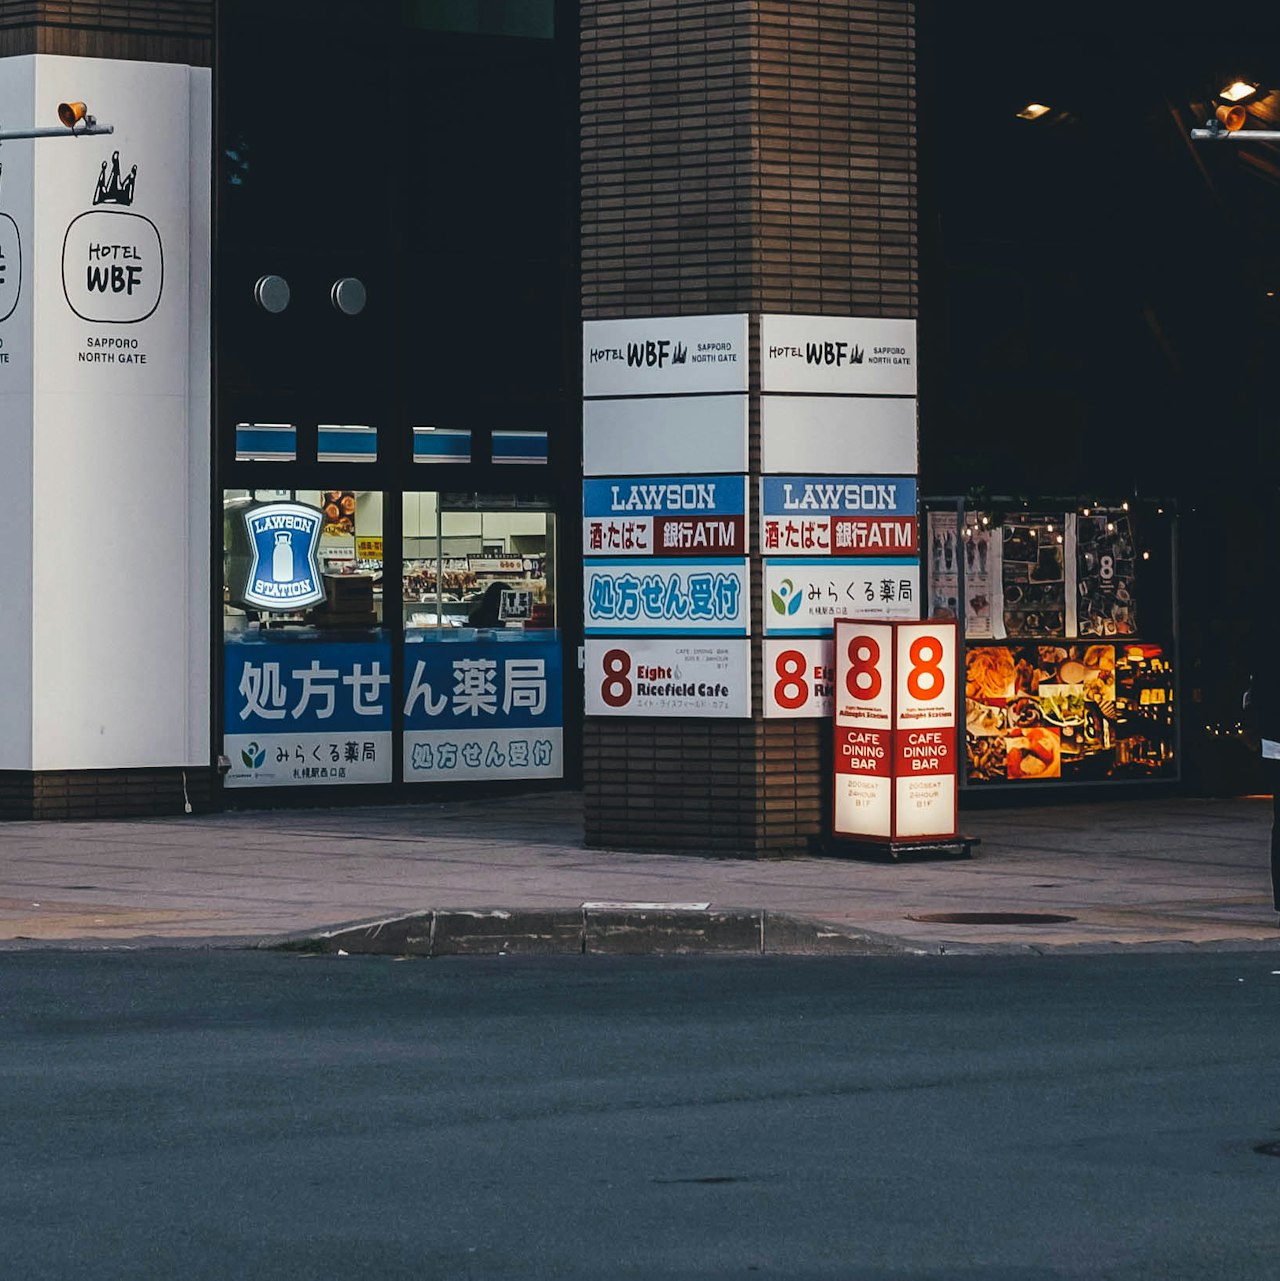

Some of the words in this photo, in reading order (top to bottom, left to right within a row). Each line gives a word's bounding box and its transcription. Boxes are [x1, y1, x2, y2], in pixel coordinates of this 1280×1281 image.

[89, 243, 142, 262] HOTEL
[87, 264, 143, 295] WBF
[87, 337, 139, 350] SAPPORO
[697, 342, 732, 352] SAPPORO
[78, 351, 115, 363] NORTH
[118, 353, 147, 365] GATE
[590, 347, 625, 363] HOTEL
[627, 340, 671, 368] WBF
[692, 354, 716, 363] NORTH
[718, 353, 737, 363] GATE
[769, 345, 804, 359] HOTEL
[806, 341, 848, 367] WBF
[893, 357, 911, 366] GATE
[611, 483, 716, 511] LAWSON
[783, 483, 898, 510] LAWSON
[255, 516, 313, 534] LAWSON
[663, 520, 736, 548] 銀行ATM
[835, 520, 912, 548] 銀行ATM
[255, 578, 312, 598] STATION
[589, 571, 741, 620] 処方せん受付
[807, 579, 913, 603] みらくる薬局
[601, 648, 633, 708] 8
[637, 665, 673, 681] Eight
[845, 635, 882, 701] 8
[907, 635, 945, 701] 8
[774, 649, 809, 709] 8
[637, 683, 696, 697] Ricefield
[698, 683, 729, 697] Cafe
[848, 732, 880, 745] CAFE
[909, 732, 942, 745] CAFE
[276, 740, 376, 764] みらくる薬局
[411, 739, 553, 770] 処方せん受付
[843, 744, 884, 758] DINING
[904, 745, 948, 758] DINING
[851, 758, 876, 770] BAR
[912, 758, 939, 770] BAR
